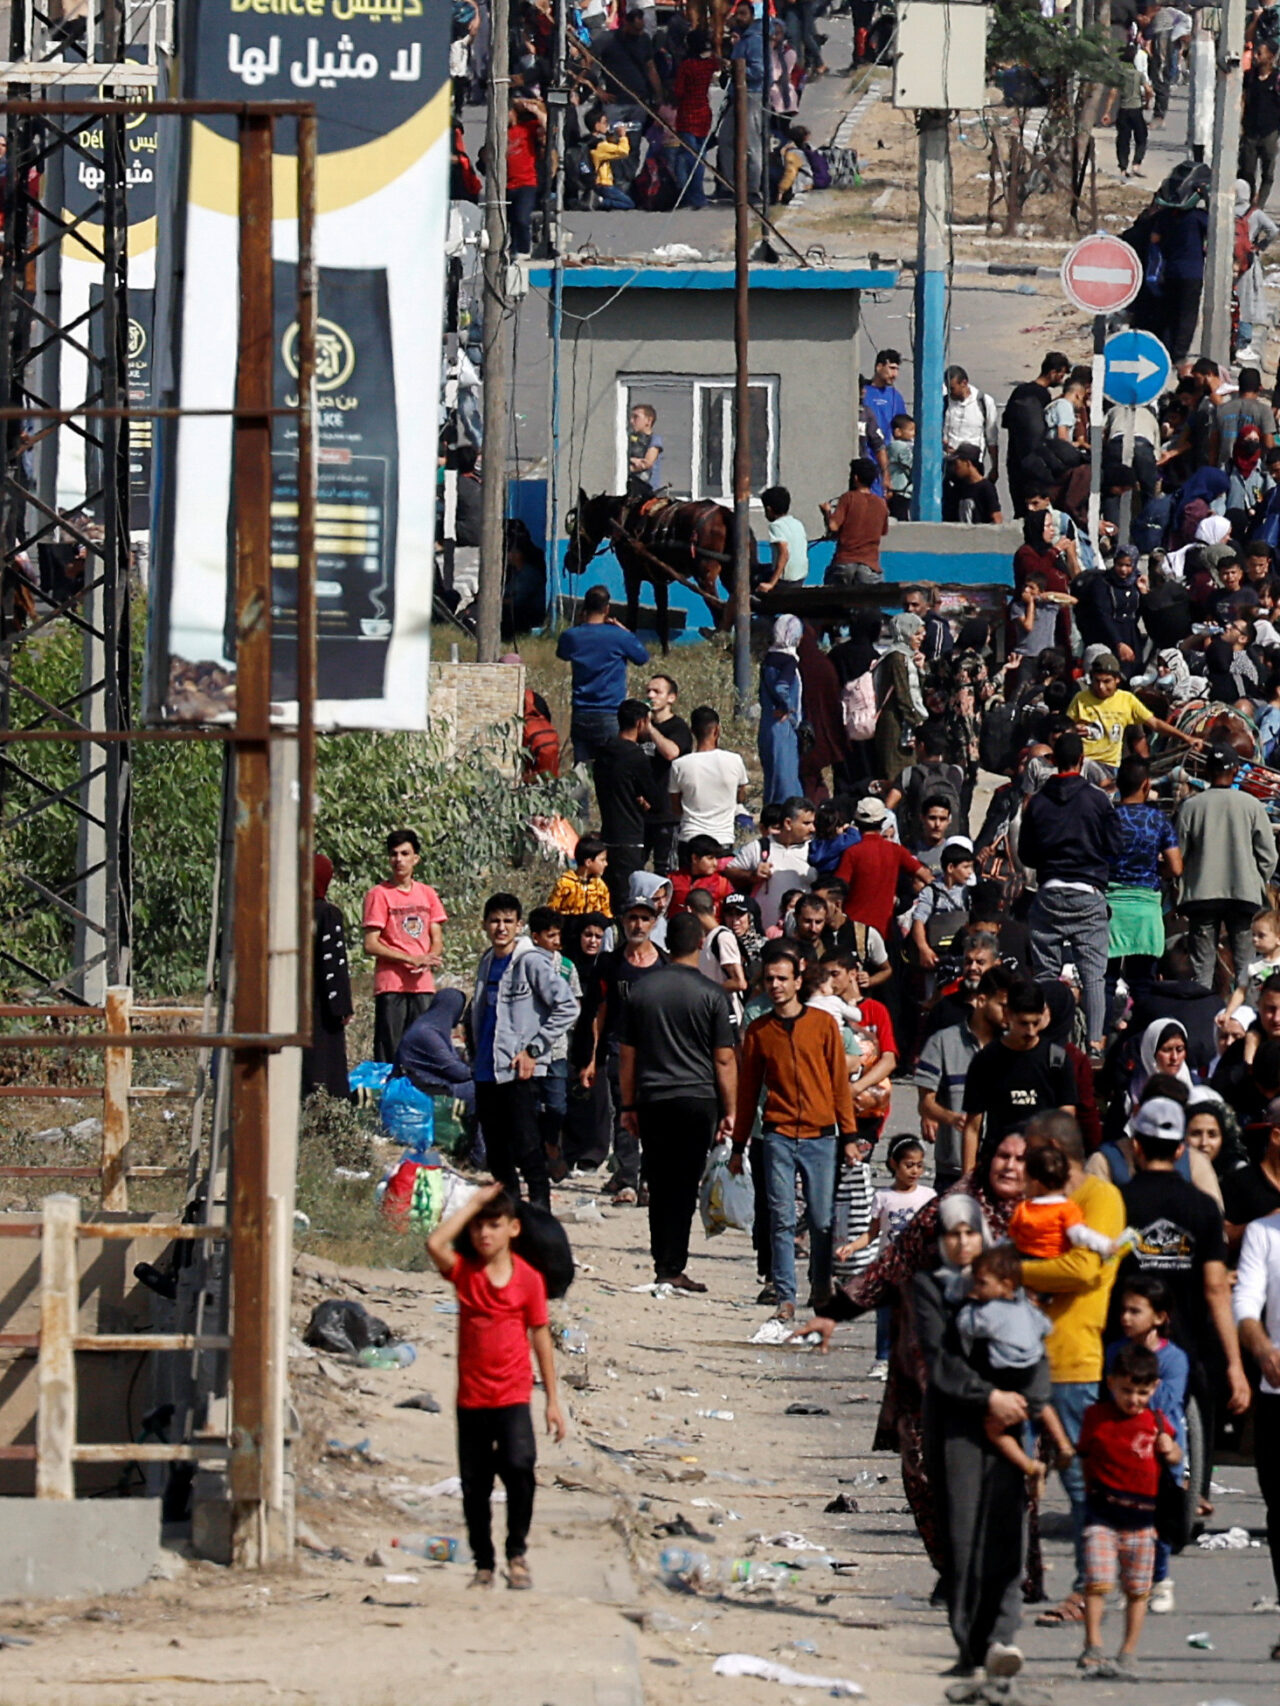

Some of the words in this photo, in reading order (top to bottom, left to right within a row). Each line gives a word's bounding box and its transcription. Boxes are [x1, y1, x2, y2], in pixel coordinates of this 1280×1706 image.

[228, 33, 281, 85] لها
[290, 34, 379, 88] مثيل
[389, 42, 422, 82] لا
